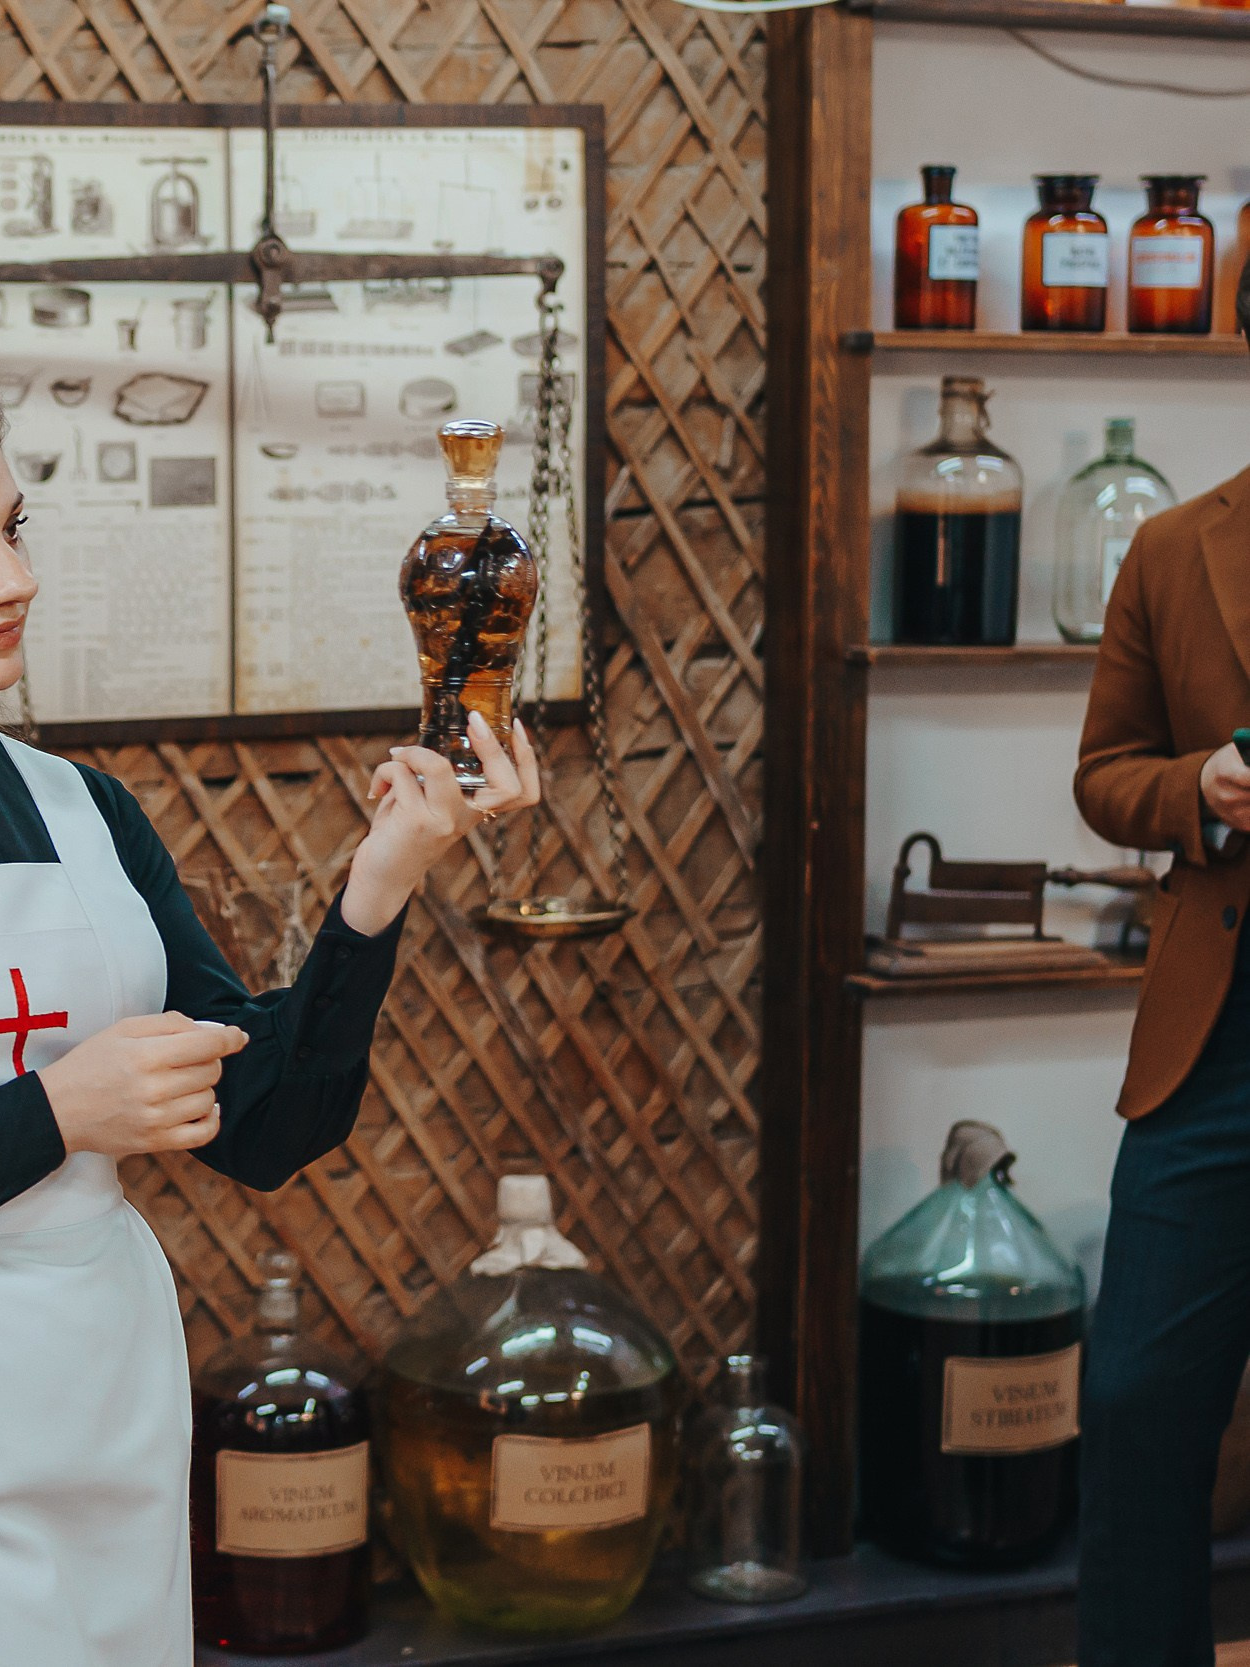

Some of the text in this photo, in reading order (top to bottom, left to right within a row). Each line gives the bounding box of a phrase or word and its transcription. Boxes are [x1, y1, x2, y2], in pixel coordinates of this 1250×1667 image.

[539, 1461, 616, 1483] VINUM
[266, 1484, 336, 1503] VINUM
[523, 1480, 627, 1505] COLCHICI
